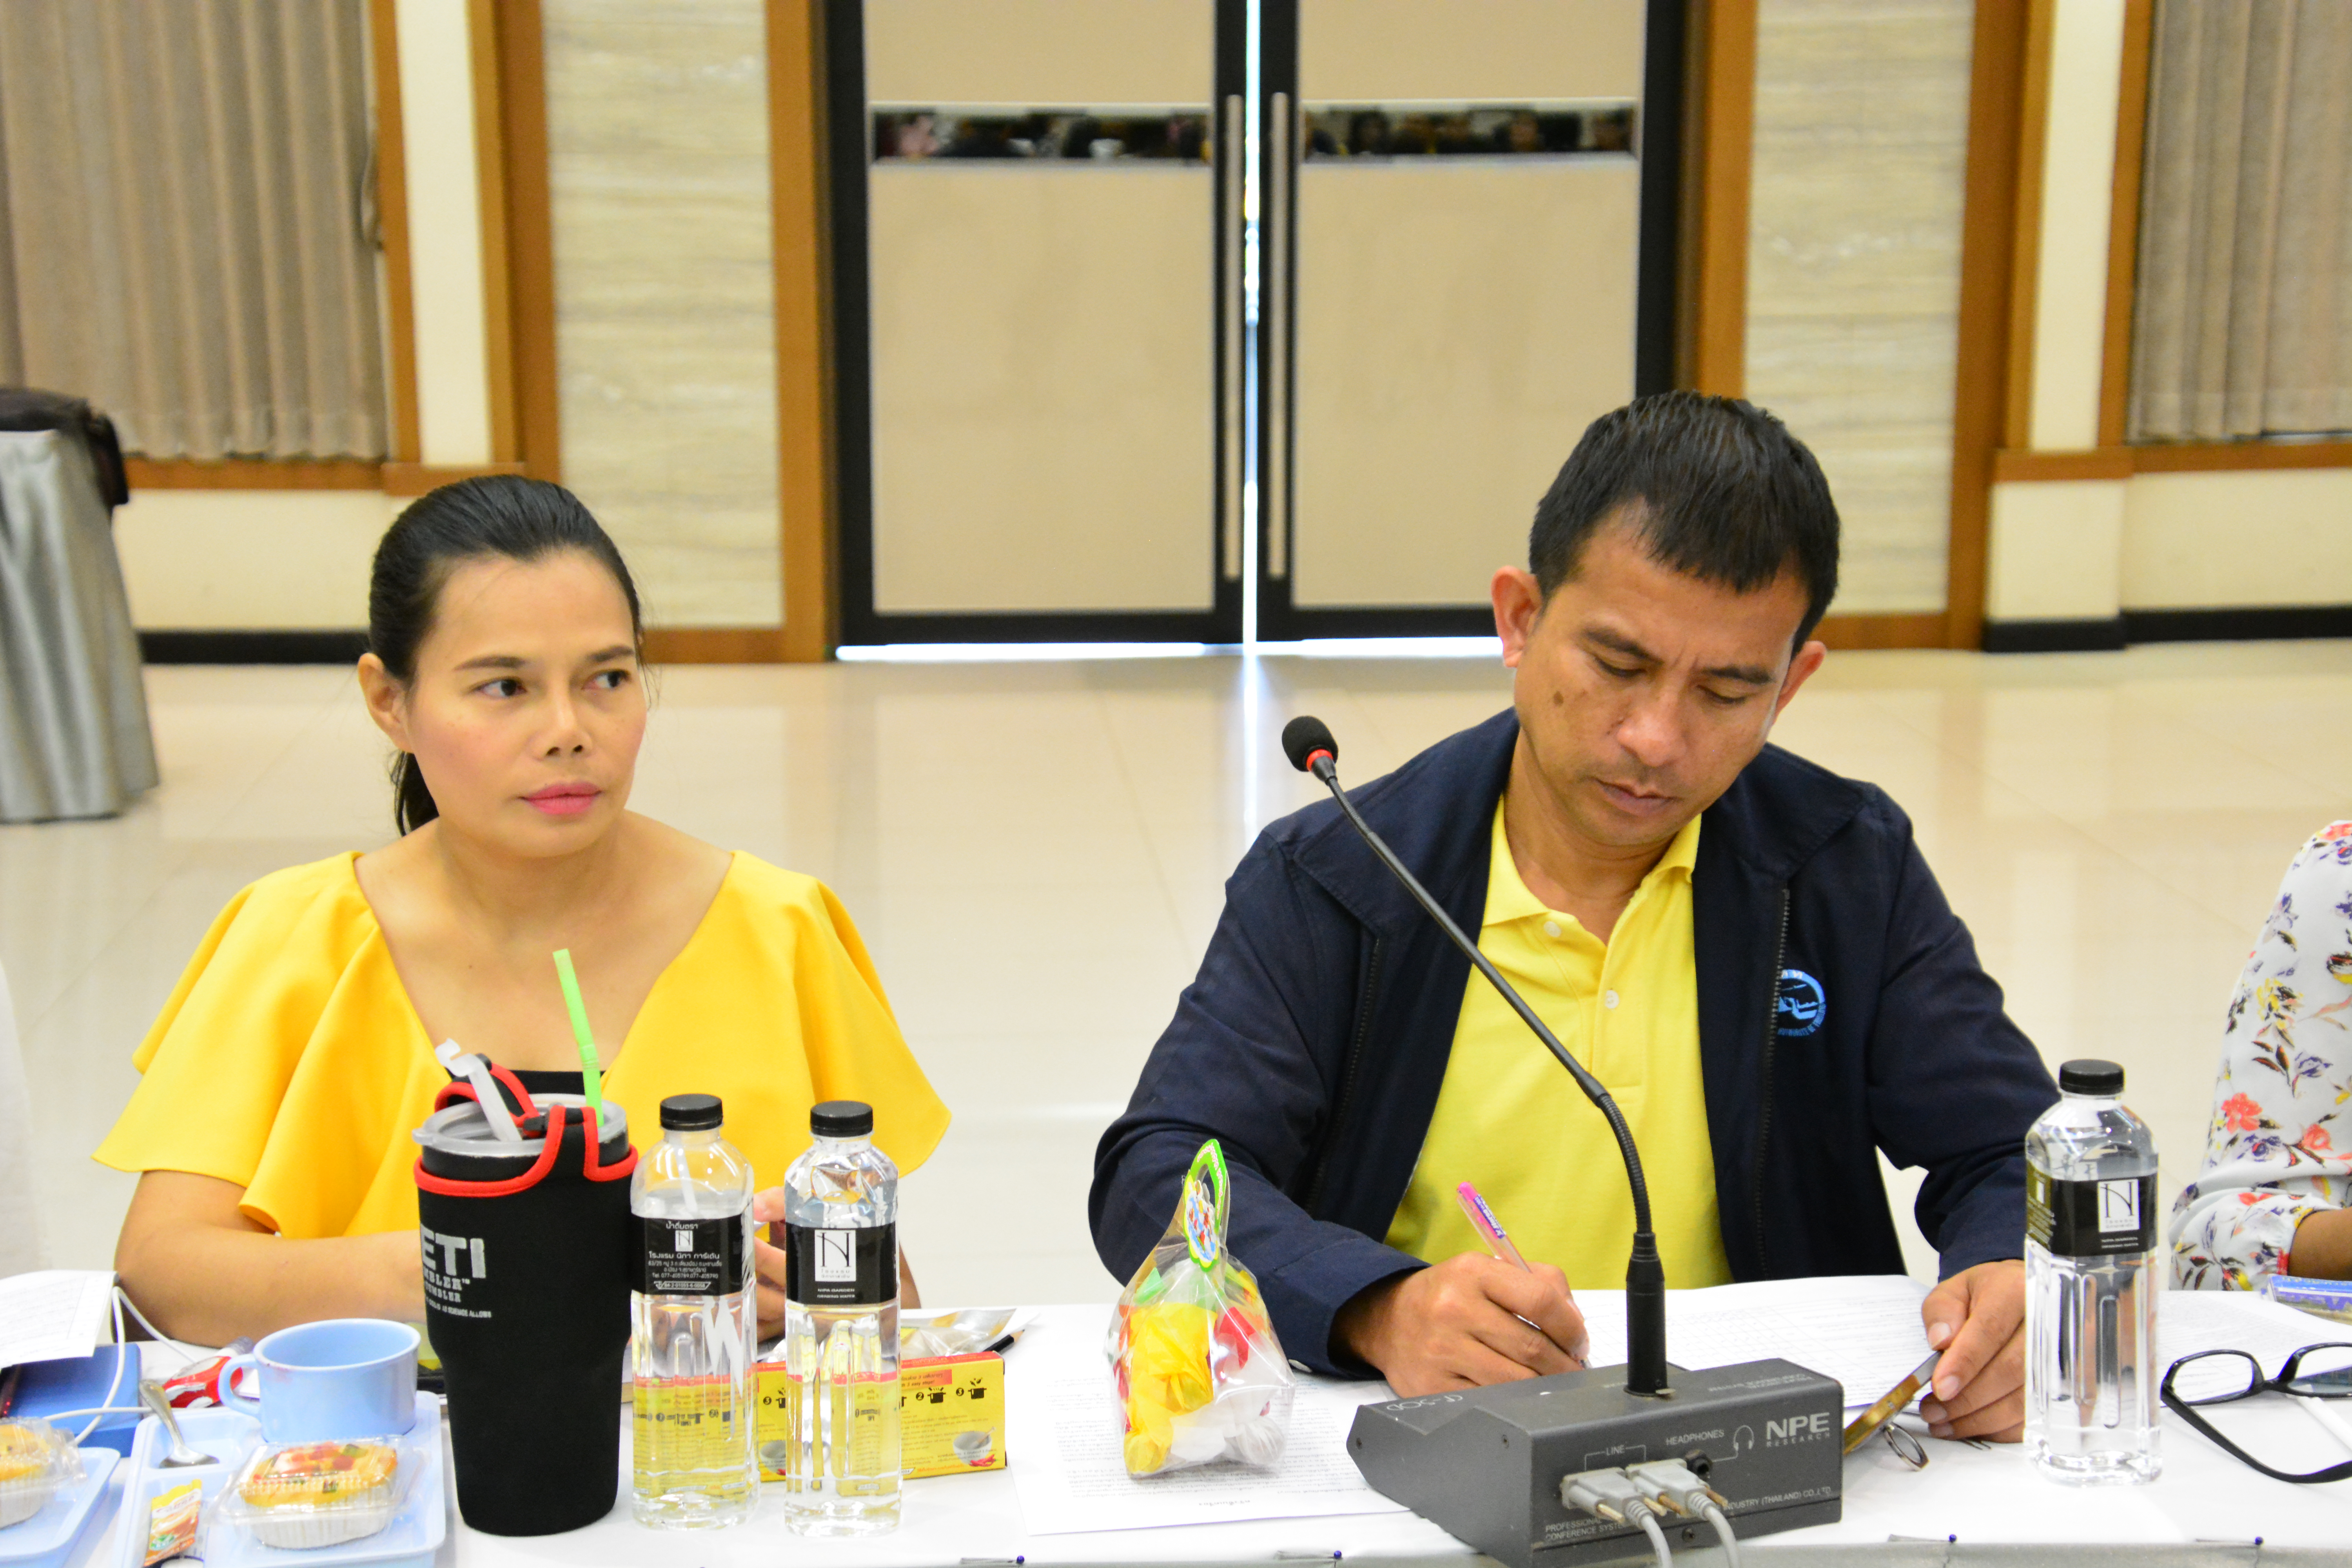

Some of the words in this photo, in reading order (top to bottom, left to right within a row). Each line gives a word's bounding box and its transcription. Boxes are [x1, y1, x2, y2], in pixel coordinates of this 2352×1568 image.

[1767, 1412, 1829, 1440] NPE
[1666, 1430, 1725, 1446] HEADPHONES
[1767, 1432, 1830, 1447] RESEARCH
[1607, 1445, 1625, 1455] LINE
[1599, 1523, 1623, 1532] SYSTE
